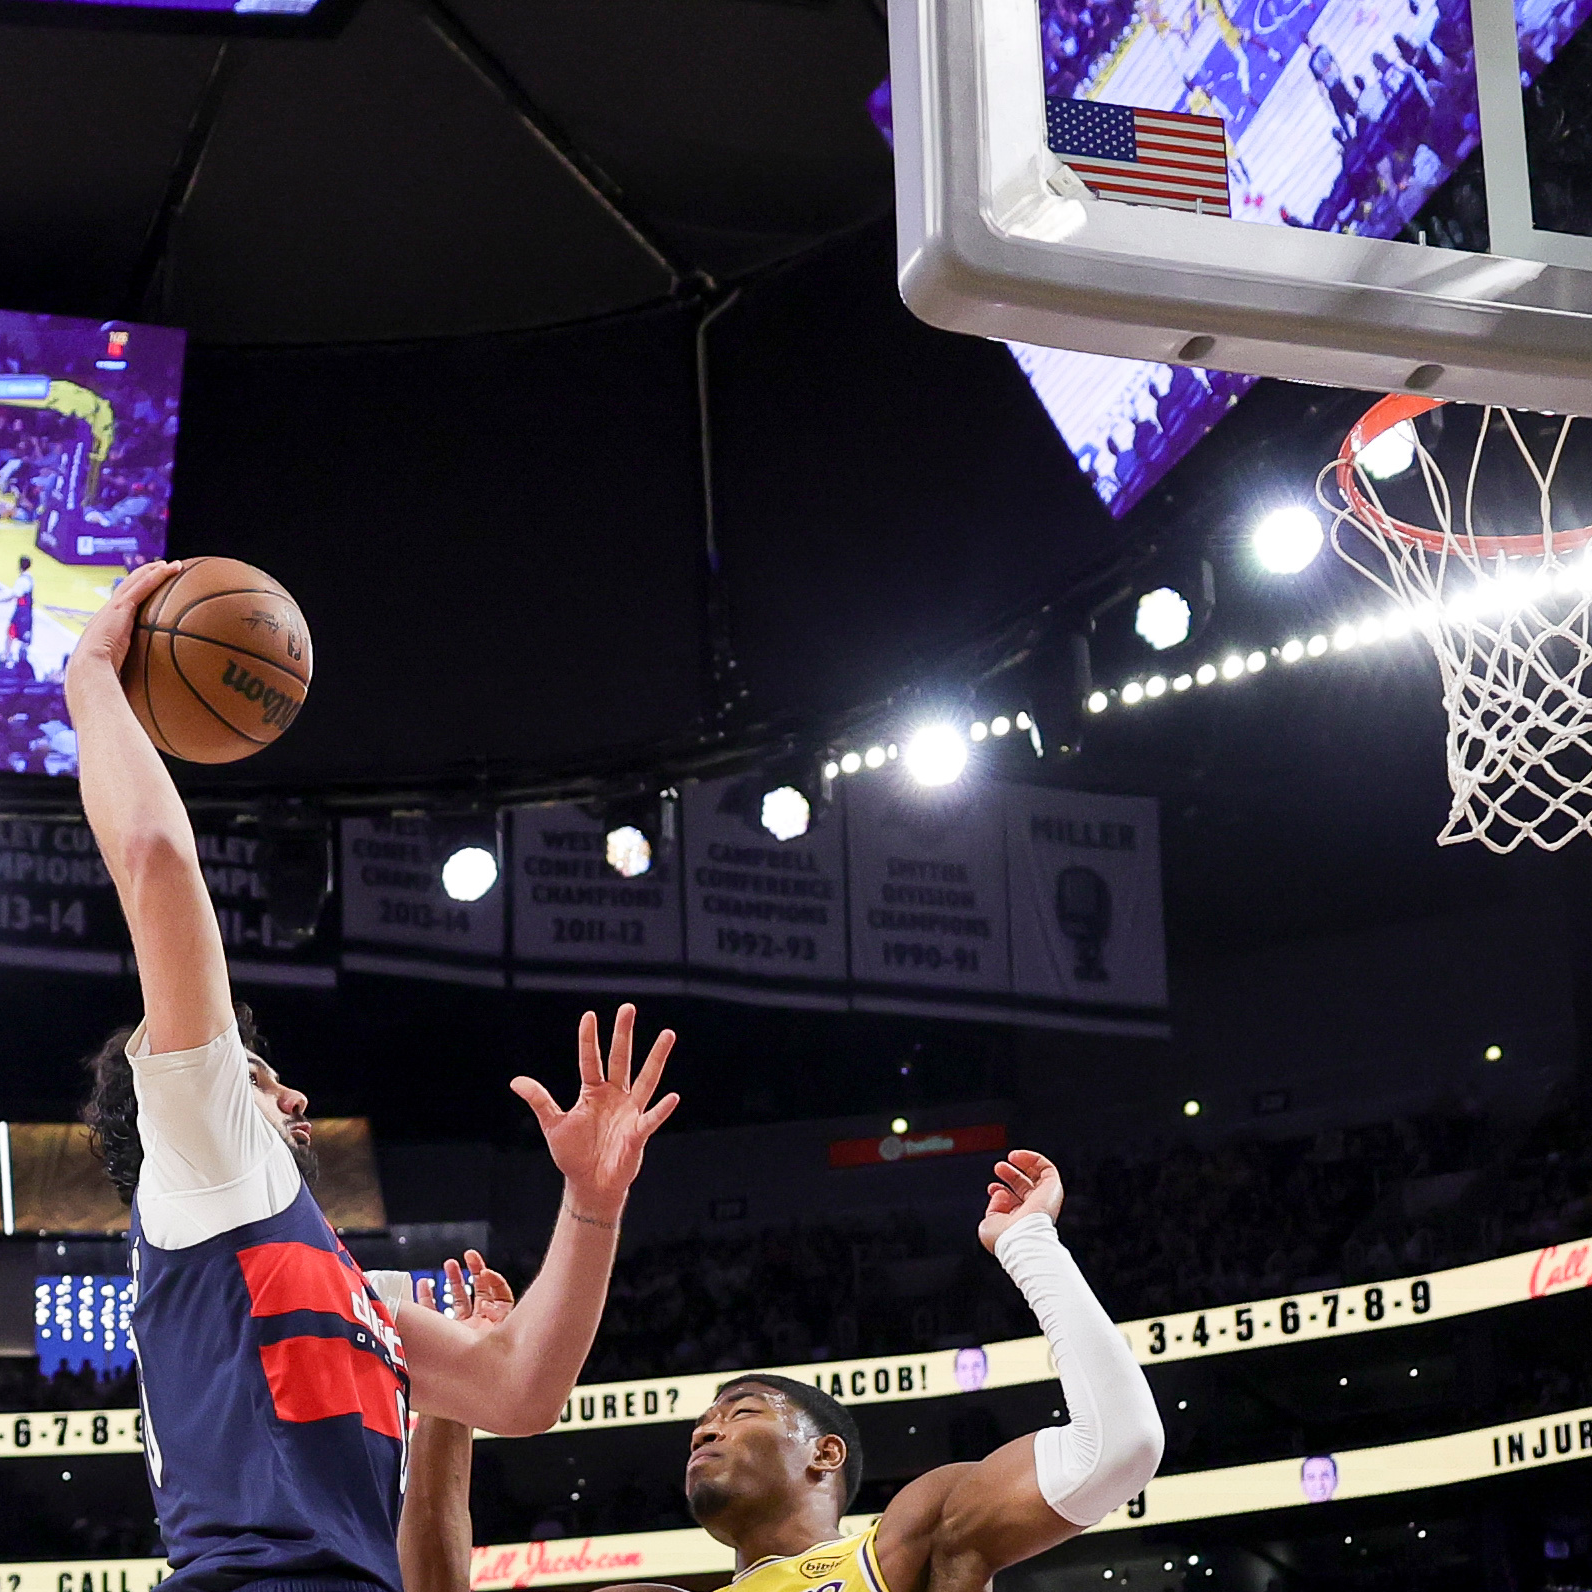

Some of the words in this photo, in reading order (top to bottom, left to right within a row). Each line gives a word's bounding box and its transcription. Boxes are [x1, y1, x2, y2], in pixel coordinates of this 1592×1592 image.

[1029, 813, 1137, 850] MILLER
[1528, 1244, 1590, 1300] Call
[559, 1387, 680, 1423] JURED?
